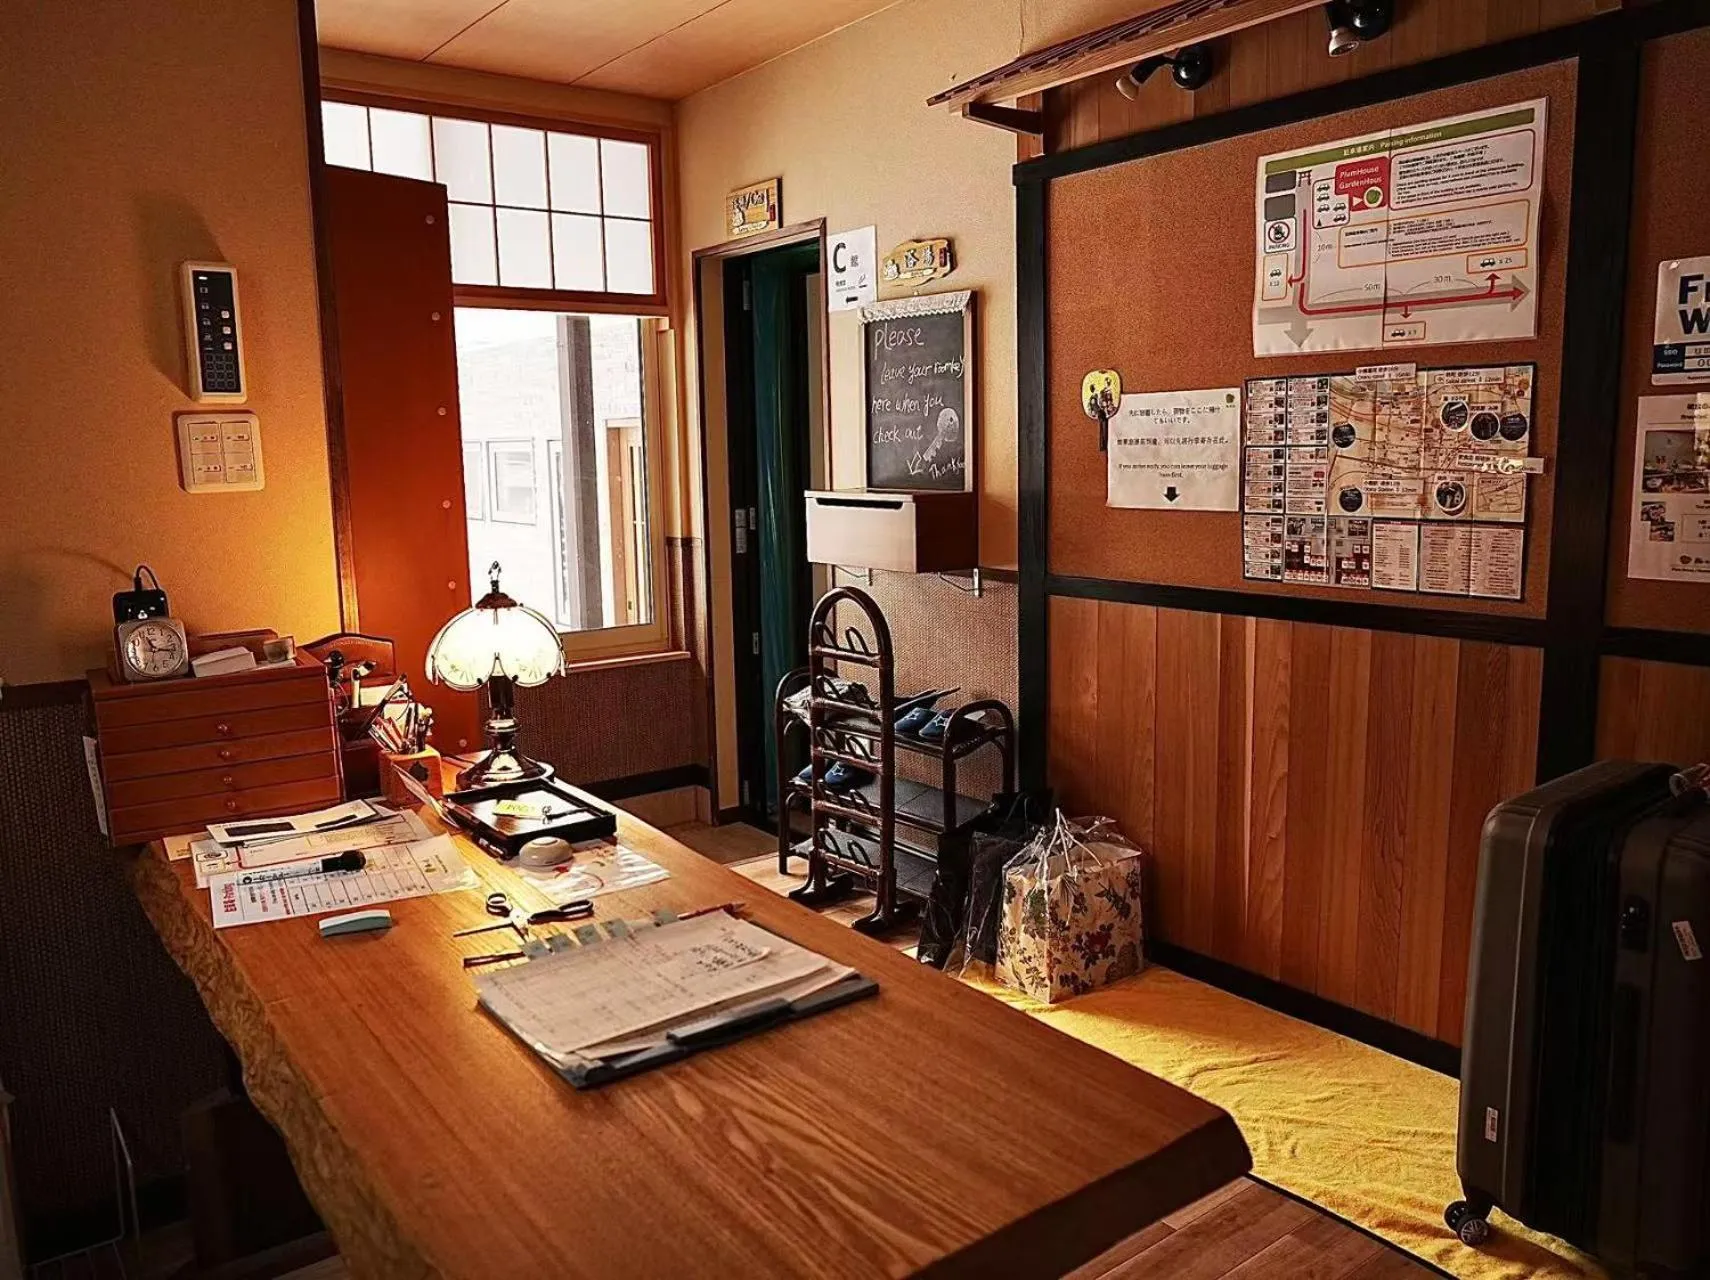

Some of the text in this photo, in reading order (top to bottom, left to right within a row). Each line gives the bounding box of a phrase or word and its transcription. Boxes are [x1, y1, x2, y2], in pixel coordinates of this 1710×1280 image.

[874, 323, 925, 361] please
[880, 361, 906, 385] leave
[908, 361, 932, 385] your
[871, 393, 944, 416] here when you
[873, 425, 924, 444] check out
